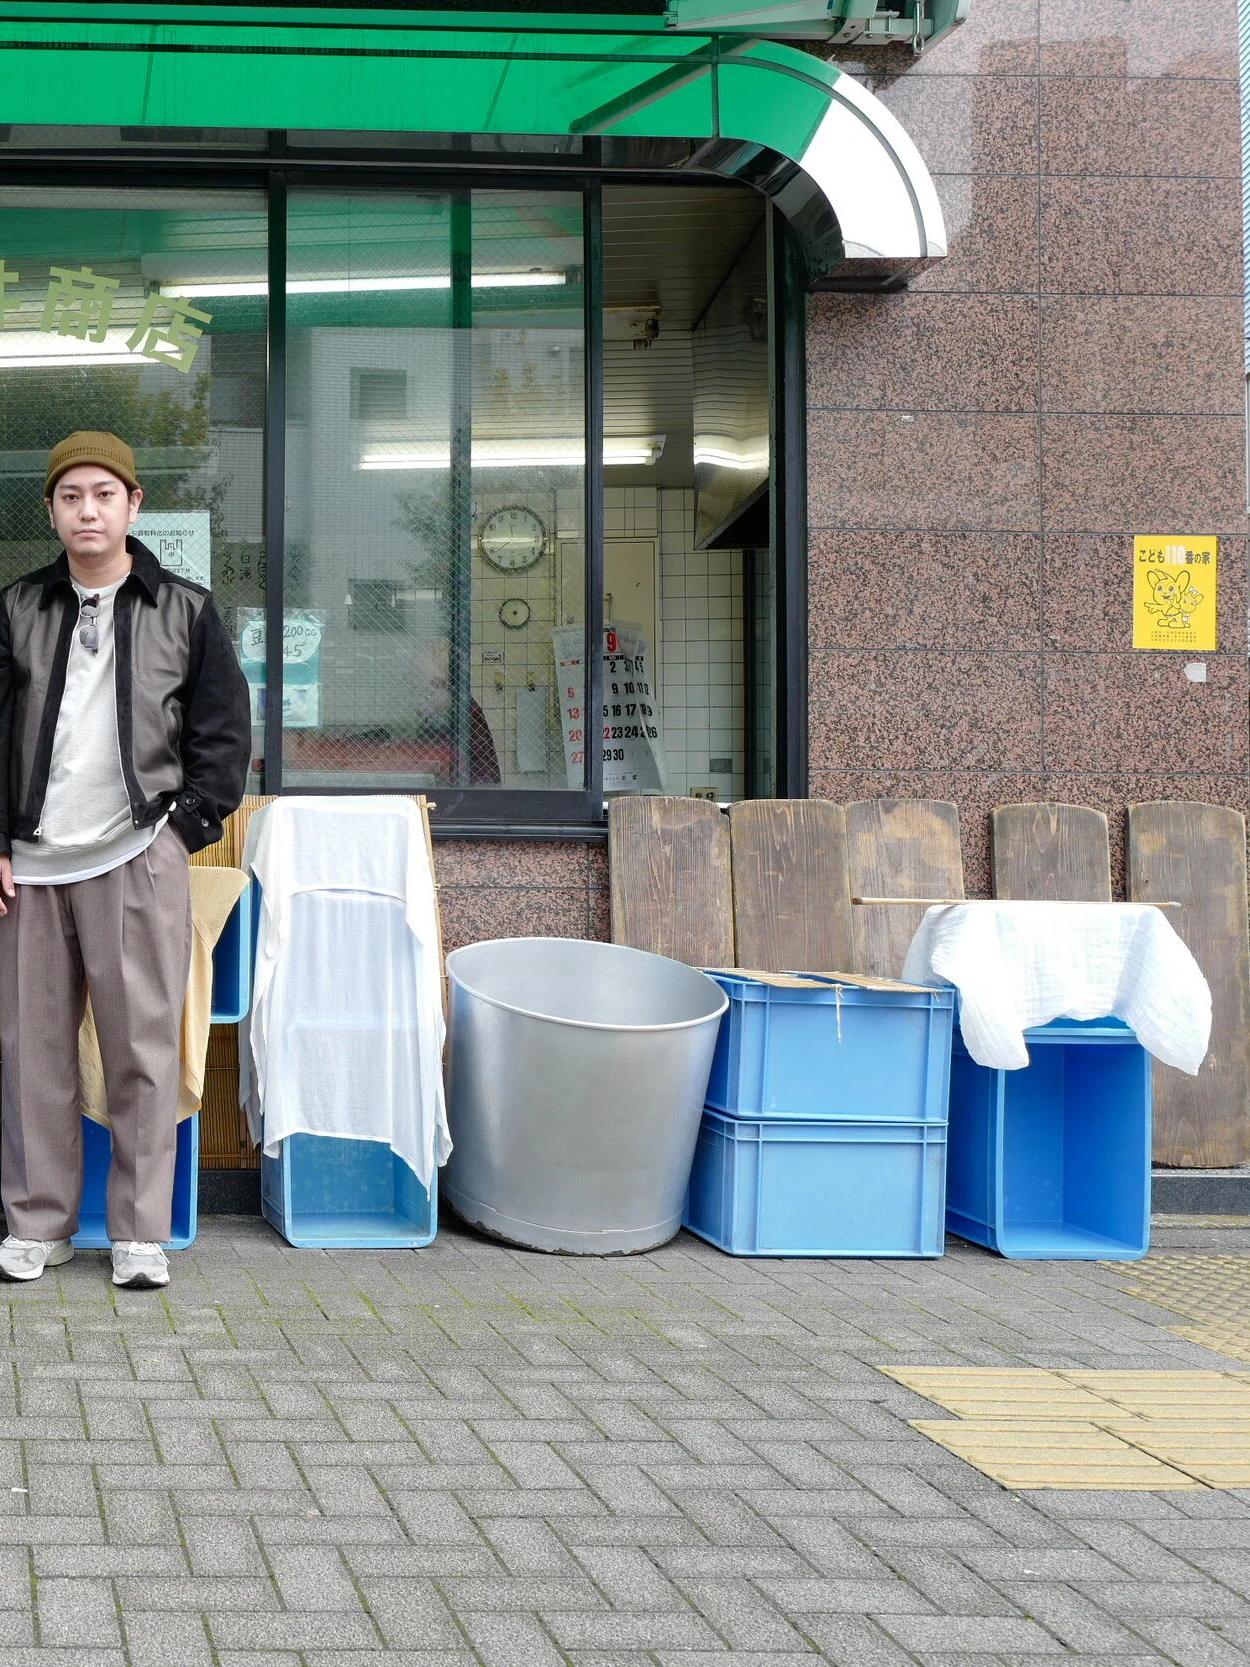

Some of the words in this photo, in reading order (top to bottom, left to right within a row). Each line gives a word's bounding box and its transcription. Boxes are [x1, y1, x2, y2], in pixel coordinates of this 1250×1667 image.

[1138, 545, 1211, 565] こども110番の家
[607, 632, 617, 652] 9
[610, 661, 617, 673] 2
[611, 683, 619, 694] 9
[623, 682, 635, 694] 10
[567, 707, 580, 719] 13
[611, 705, 621, 717] 16
[625, 704, 637, 716] 17
[568, 730, 583, 742] 20
[602, 727, 610, 739] 2
[611, 727, 623, 739] 23
[625, 726, 638, 738] 24
[571, 751, 584, 763] 27
[602, 749, 612, 761] 29
[613, 748, 624, 761] 30
